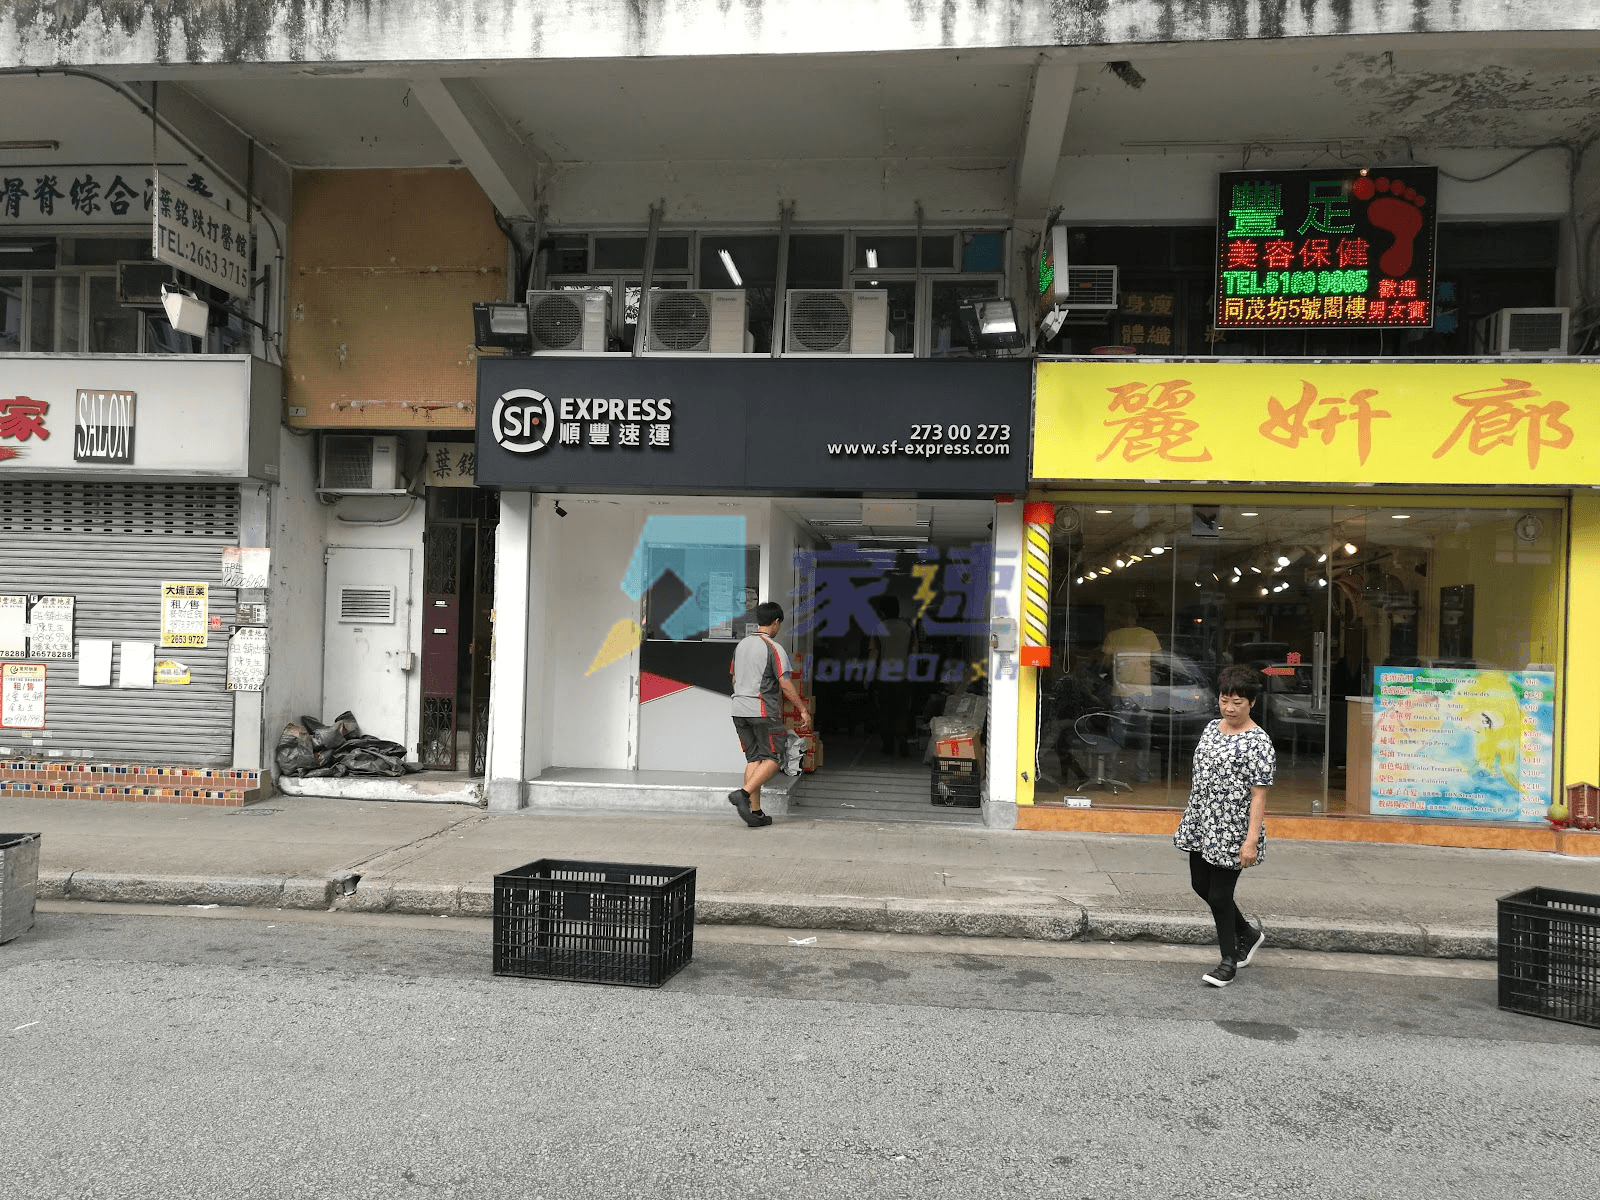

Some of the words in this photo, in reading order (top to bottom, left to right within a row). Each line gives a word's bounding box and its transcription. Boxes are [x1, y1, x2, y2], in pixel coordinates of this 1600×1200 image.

[158, 187, 248, 259] 葉銘跌打醫館
[1227, 236, 1370, 269] 美容保健
[220, 257, 248, 289] 3715
[1378, 278, 1418, 299] 歡迎
[1225, 295, 1368, 321] 同茂坊5號閣樓
[77, 392, 132, 458] SALON
[503, 405, 543, 437] SF
[560, 397, 672, 421] EXPRESS
[1096, 378, 1574, 470] 麗妍廊
[559, 423, 671, 446] 順豐速運
[910, 424, 943, 440] 273
[948, 424, 971, 440] 00
[976, 424, 1011, 440] 273
[827, 440, 1010, 458] www.sf-express.com
[170, 635, 187, 644] 2653
[188, 635, 205, 644] 9722
[31, 650, 72, 658] 26578288
